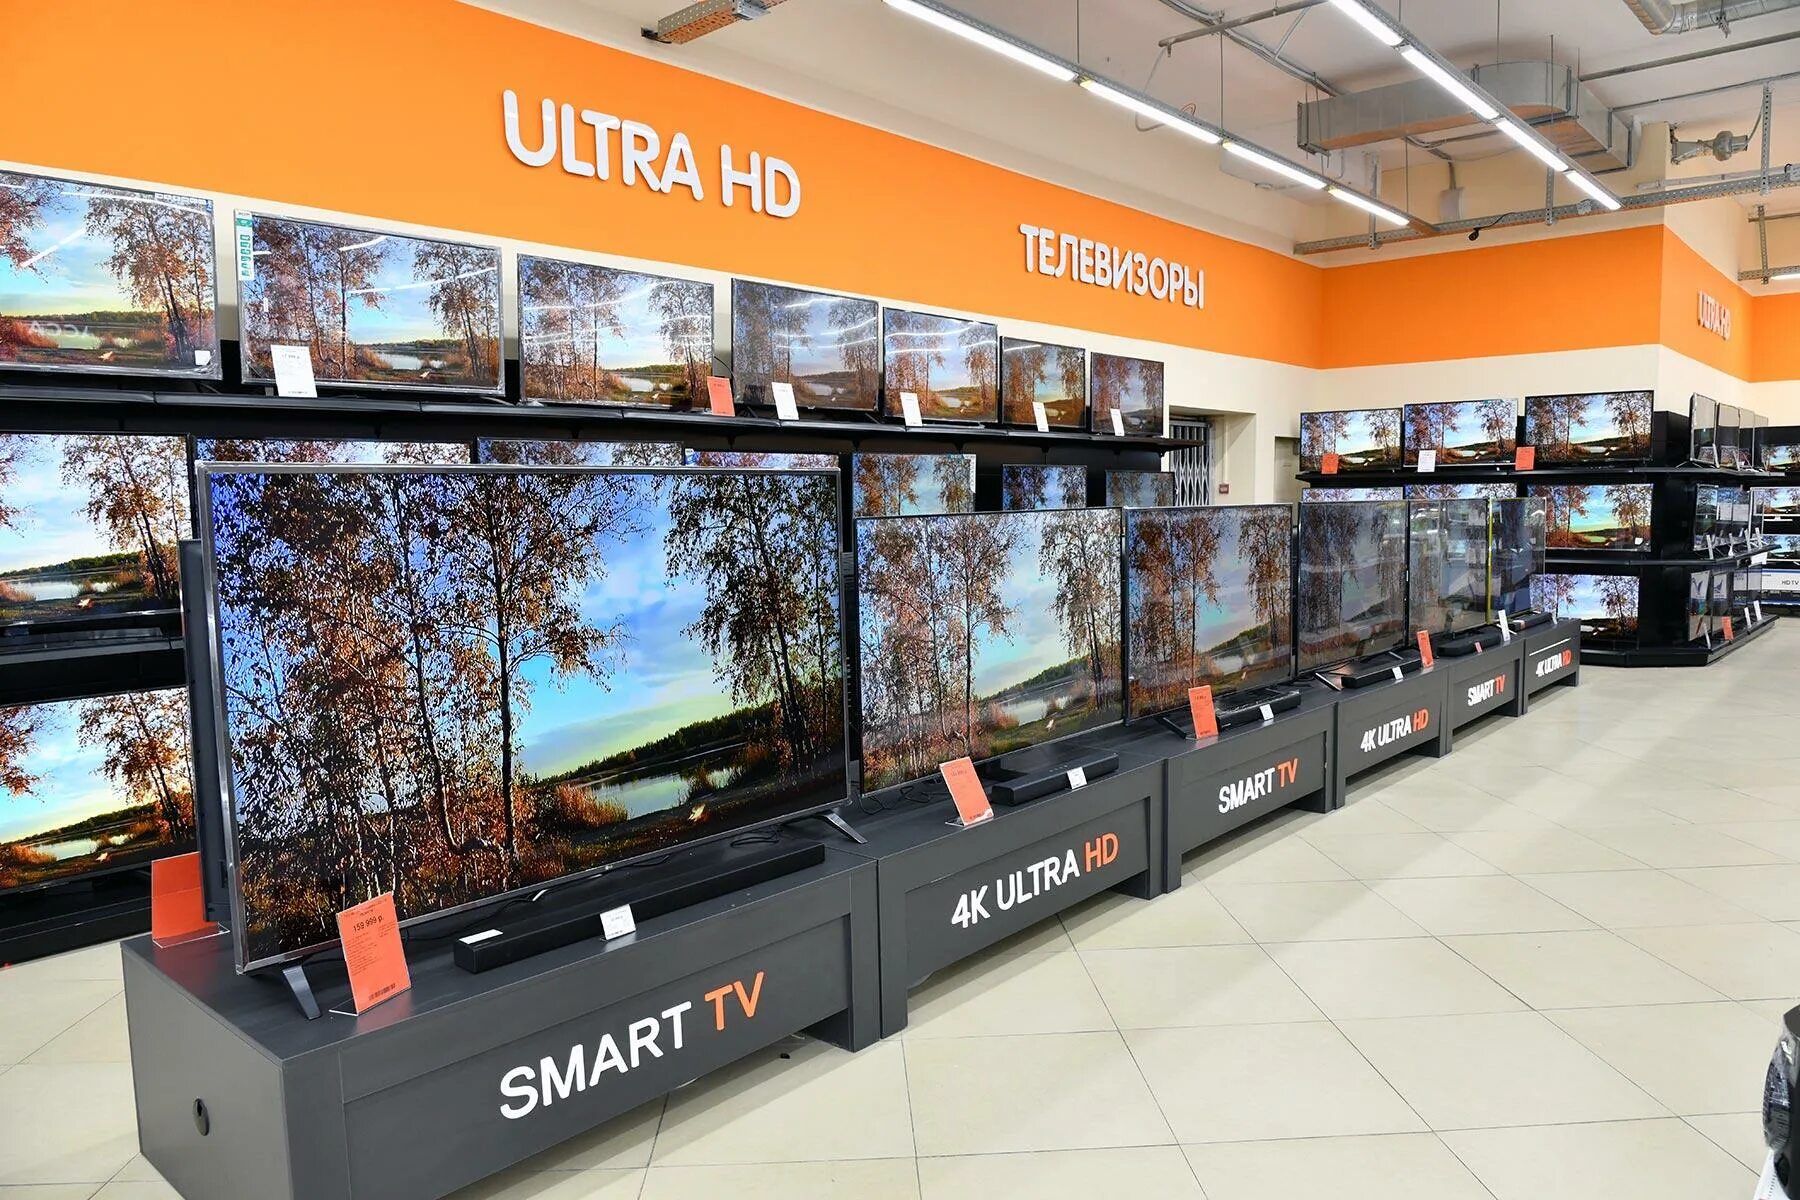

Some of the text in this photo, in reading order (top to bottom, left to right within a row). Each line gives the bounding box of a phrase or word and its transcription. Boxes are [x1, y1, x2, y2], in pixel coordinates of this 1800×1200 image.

[503, 90, 801, 218] ULTRA HD
[1019, 224, 1205, 309] ТЕЛЕВИЗОРЫ
[1697, 289, 1731, 341] ULTRA HD
[1468, 674, 1506, 706] SMART TV
[1361, 708, 1428, 752] 4K ULTRA HD
[1218, 758, 1299, 813] SMART TV
[951, 832, 1118, 929] 4K ULTRA HD
[500, 970, 765, 1120] SMART TV
